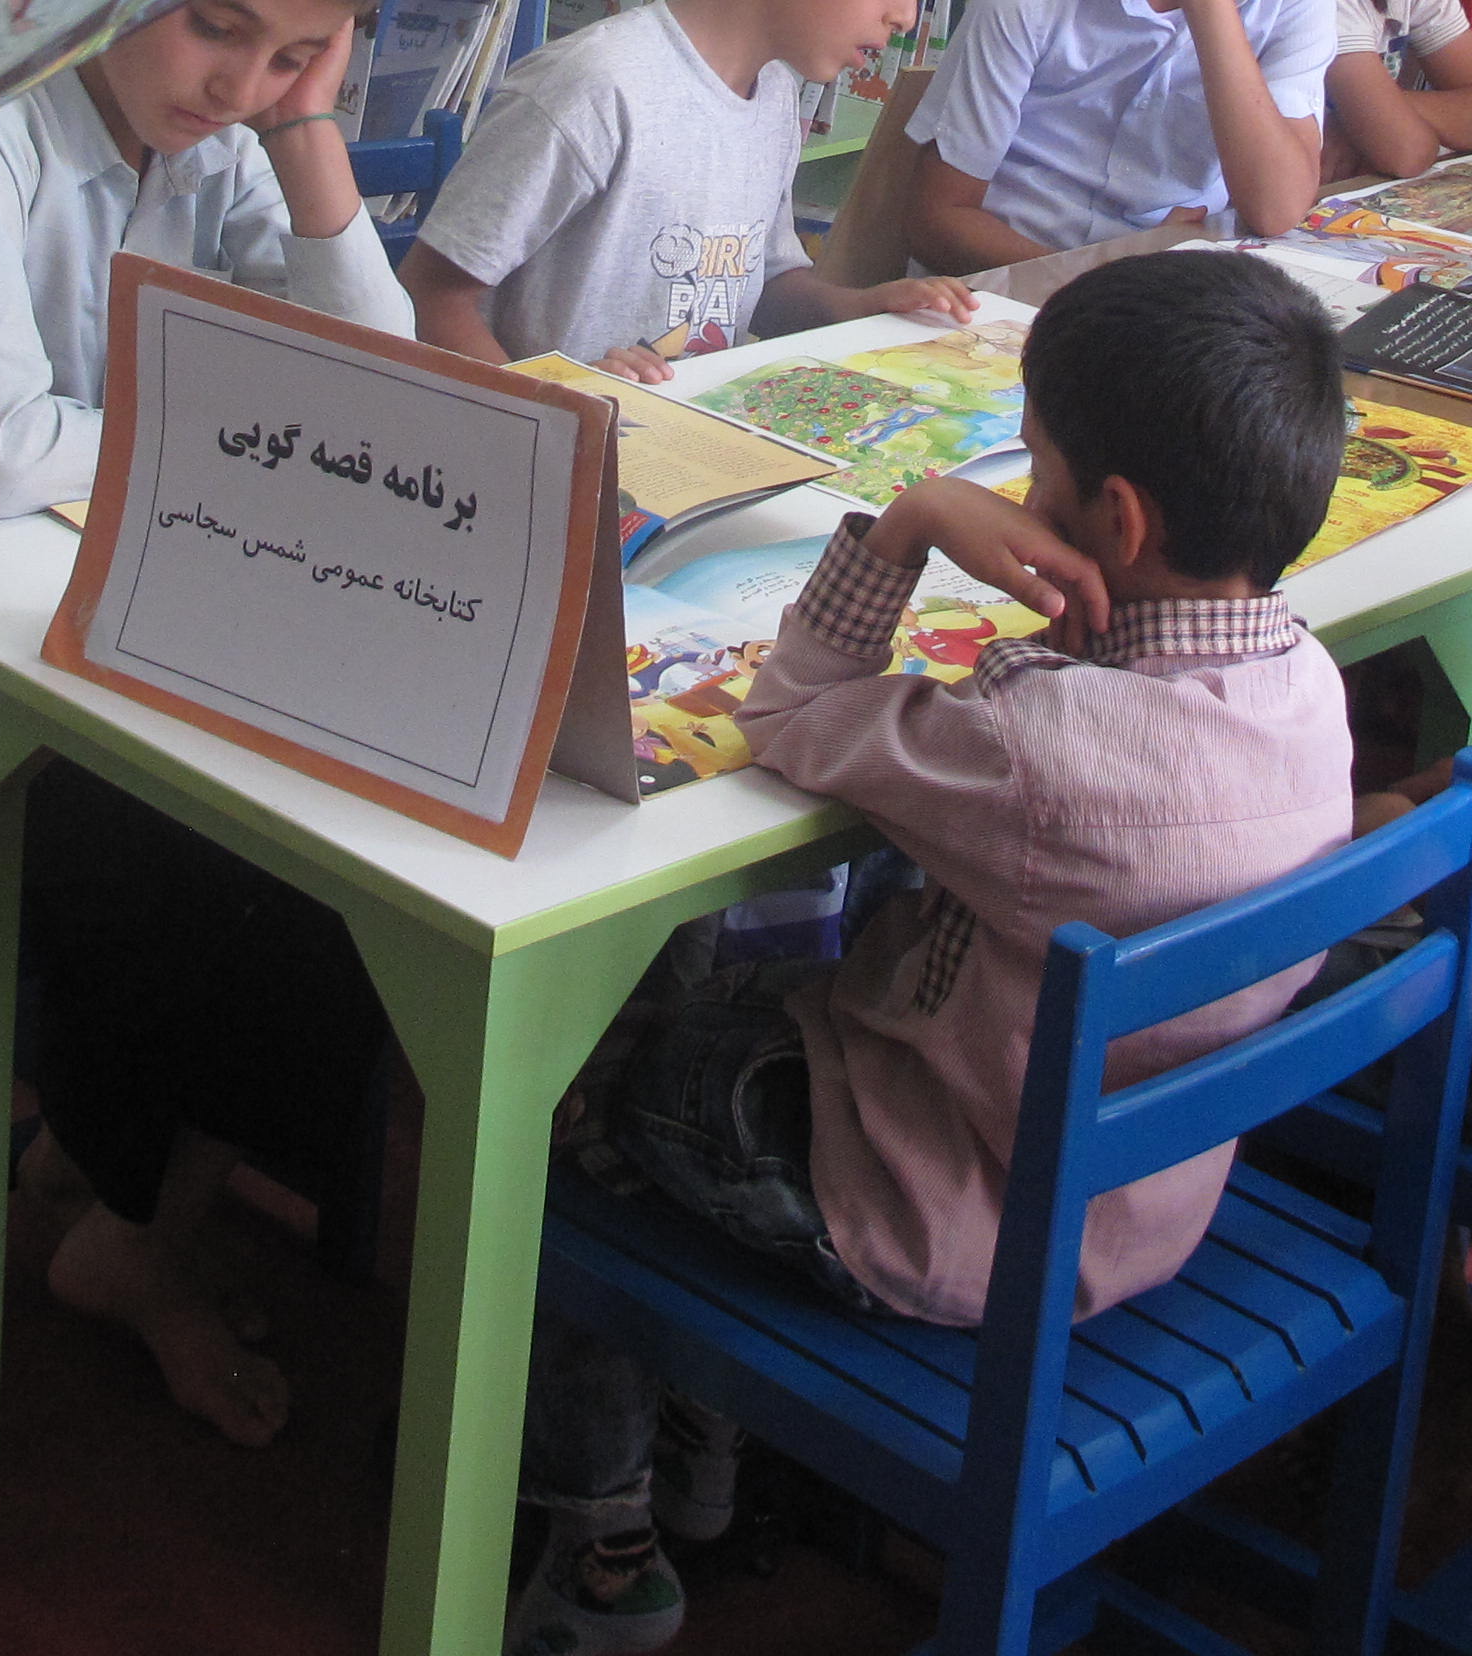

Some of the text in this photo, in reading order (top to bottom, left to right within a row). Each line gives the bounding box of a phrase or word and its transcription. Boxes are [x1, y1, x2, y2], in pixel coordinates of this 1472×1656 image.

[218, 422, 477, 533] برنامه قصه گویی
[158, 502, 483, 622] کتابخانه عمومی شمس سجاسی
